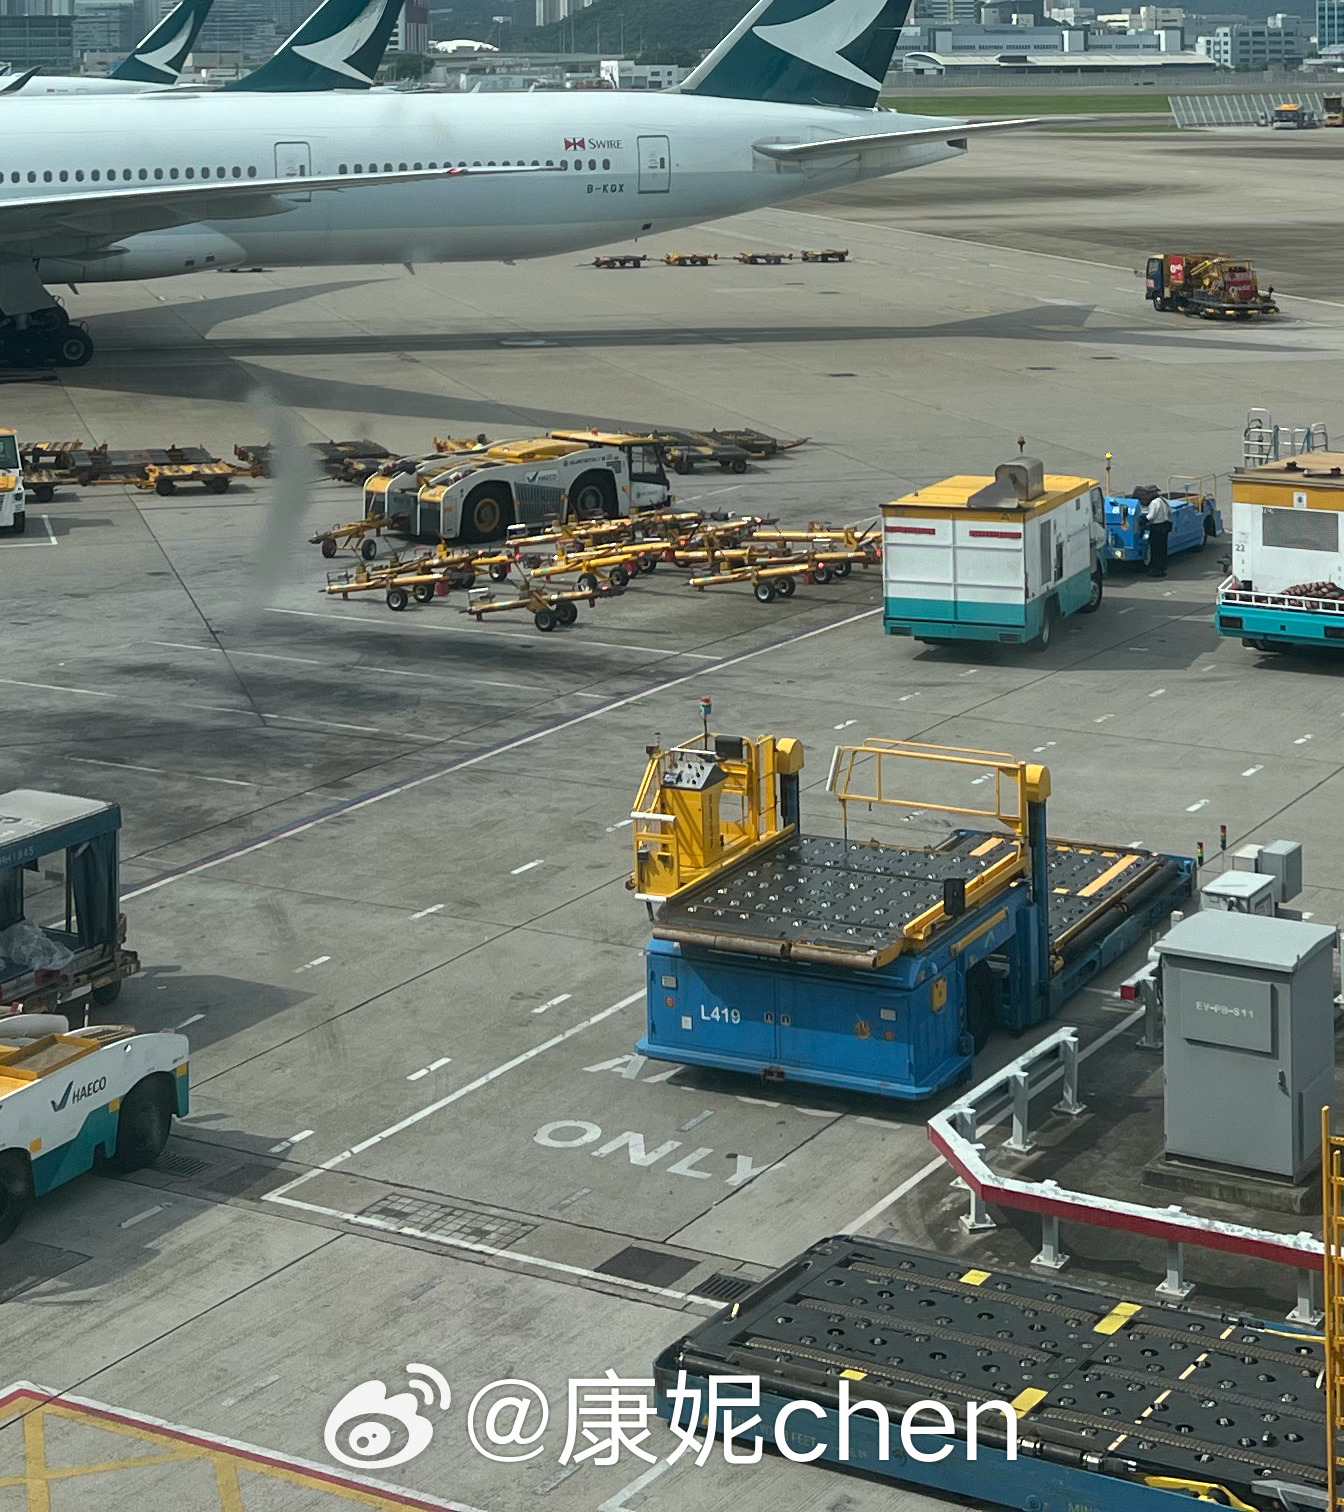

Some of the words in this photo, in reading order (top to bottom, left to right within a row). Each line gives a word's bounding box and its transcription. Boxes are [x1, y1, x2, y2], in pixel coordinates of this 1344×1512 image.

[1235, 543, 1246, 552] 22
[700, 1003, 741, 1025] L419
[72, 1076, 107, 1105] HAECO
[532, 1119, 787, 1187] ONLY
